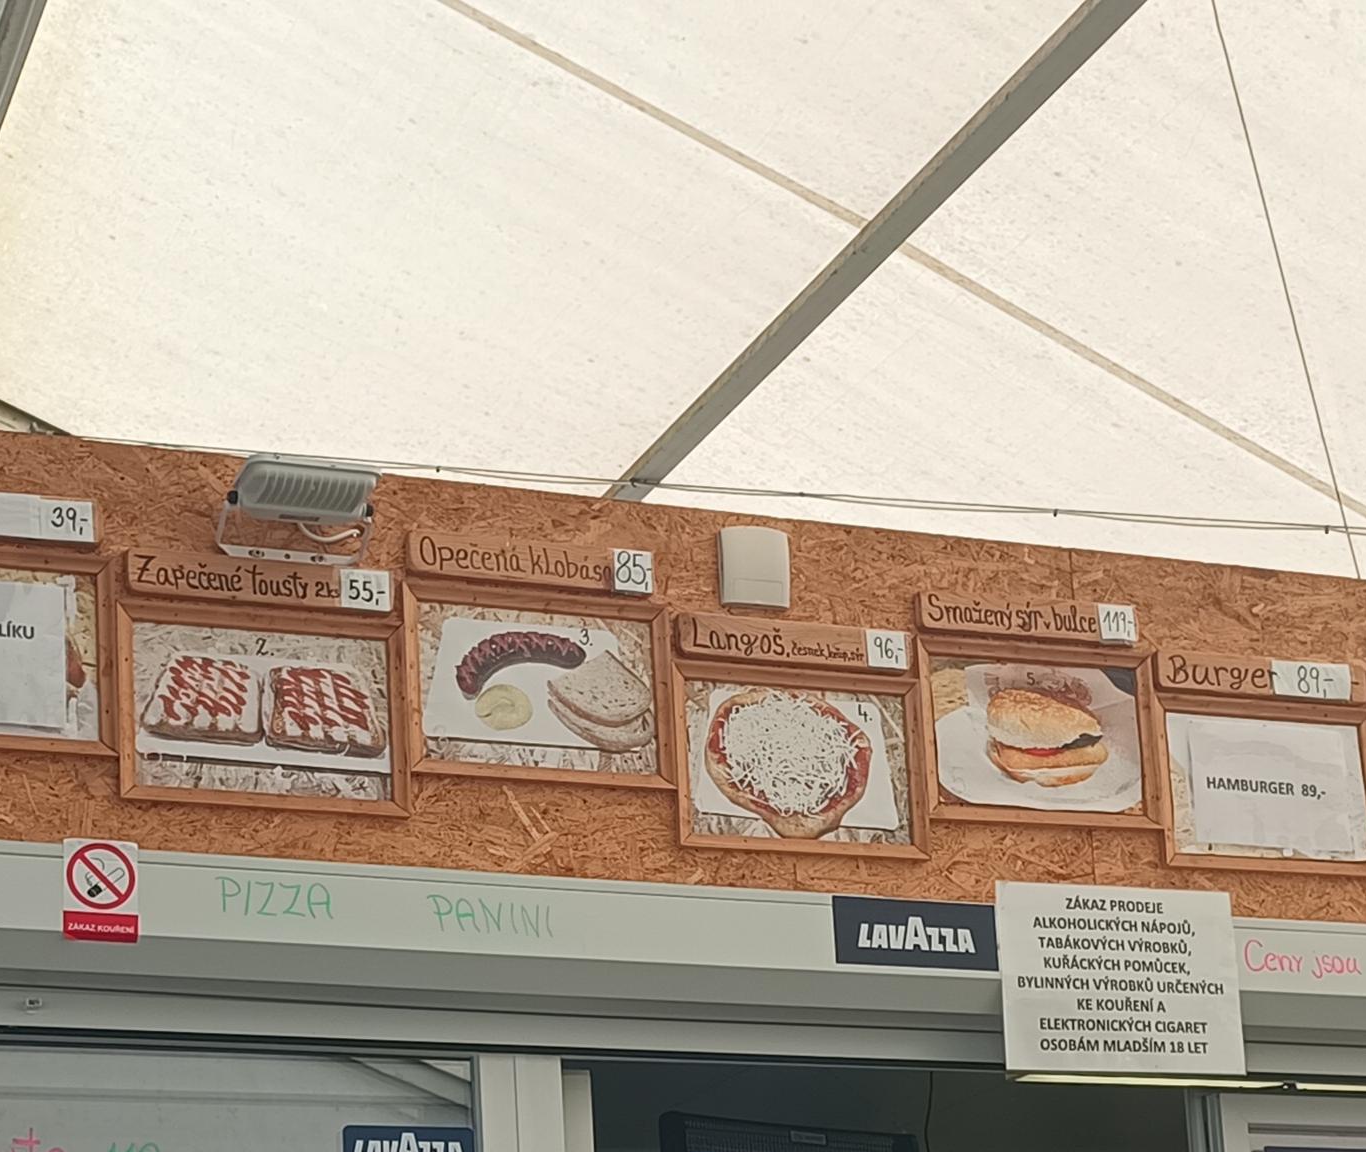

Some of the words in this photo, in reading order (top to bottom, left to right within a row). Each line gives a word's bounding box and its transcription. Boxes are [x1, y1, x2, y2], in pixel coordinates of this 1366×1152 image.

[52, 506, 90, 535] 39,-
[419, 536, 525, 572] Opečená
[135, 555, 243, 592] Zapečené
[349, 579, 386, 605] 55,-
[874, 636, 903, 664] 96,-
[1166, 655, 1277, 690] Burger
[1296, 665, 1334, 699] 89,-
[1205, 776, 1295, 796] HAMBURGER
[1301, 784, 1327, 800] 89,-
[215, 875, 335, 920] PIZZA
[426, 893, 554, 939] PANINI
[1064, 895, 1108, 912] ZÁKAZ
[1109, 898, 1165, 914] PRODEJE
[67, 921, 95, 933] ZÁKAZ
[97, 921, 135, 935] KOUŘENÍ
[857, 915, 977, 955] LAVAZZA
[1033, 914, 1138, 933] ALKOHOLICKÝCH
[1140, 918, 1196, 938] NÁPOJŮ,
[1037, 933, 1125, 953] TABÁKOVÝCH
[1128, 937, 1193, 957] VÝROBKŮ,
[1043, 952, 1121, 972] KUŘÁCKÝCH
[1123, 956, 1191, 976] POMŮCEK,
[1243, 939, 1304, 976] Ceny
[1312, 952, 1362, 978] jsou
[1017, 972, 1090, 991] BYLINNÝCH
[1092, 975, 1155, 993] VÝROBKŮ
[1156, 977, 1224, 996] URČENÝCH
[1076, 997, 1093, 1012] KE
[1095, 996, 1155, 1013] KOUŘENÍ
[1156, 999, 1166, 1013] A
[1039, 1015, 1152, 1034] ELEKTRONICKÝCH
[1154, 1019, 1208, 1035] CIGARET
[1039, 1035, 1099, 1053] OSOBÁM
[1102, 1037, 1167, 1055] MLADŠÍM
[1169, 1040, 1184, 1054] 18
[1187, 1040, 1209, 1055] LET
